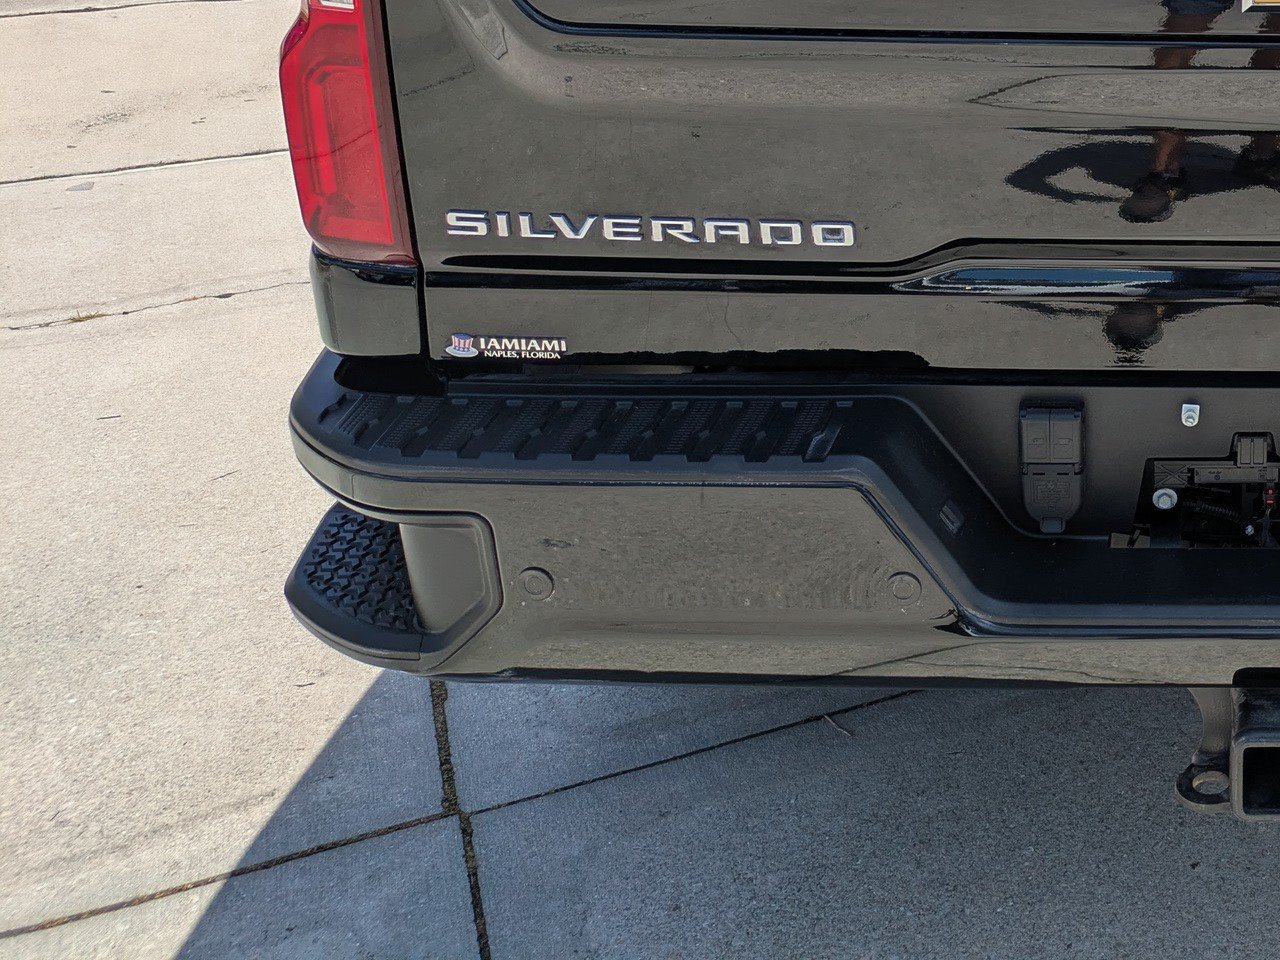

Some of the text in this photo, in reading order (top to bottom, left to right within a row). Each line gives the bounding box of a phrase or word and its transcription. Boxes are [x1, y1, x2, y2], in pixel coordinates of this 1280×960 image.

[446, 208, 856, 247] SILVERADO
[484, 350, 561, 359] NAPLES, FLORIDA
